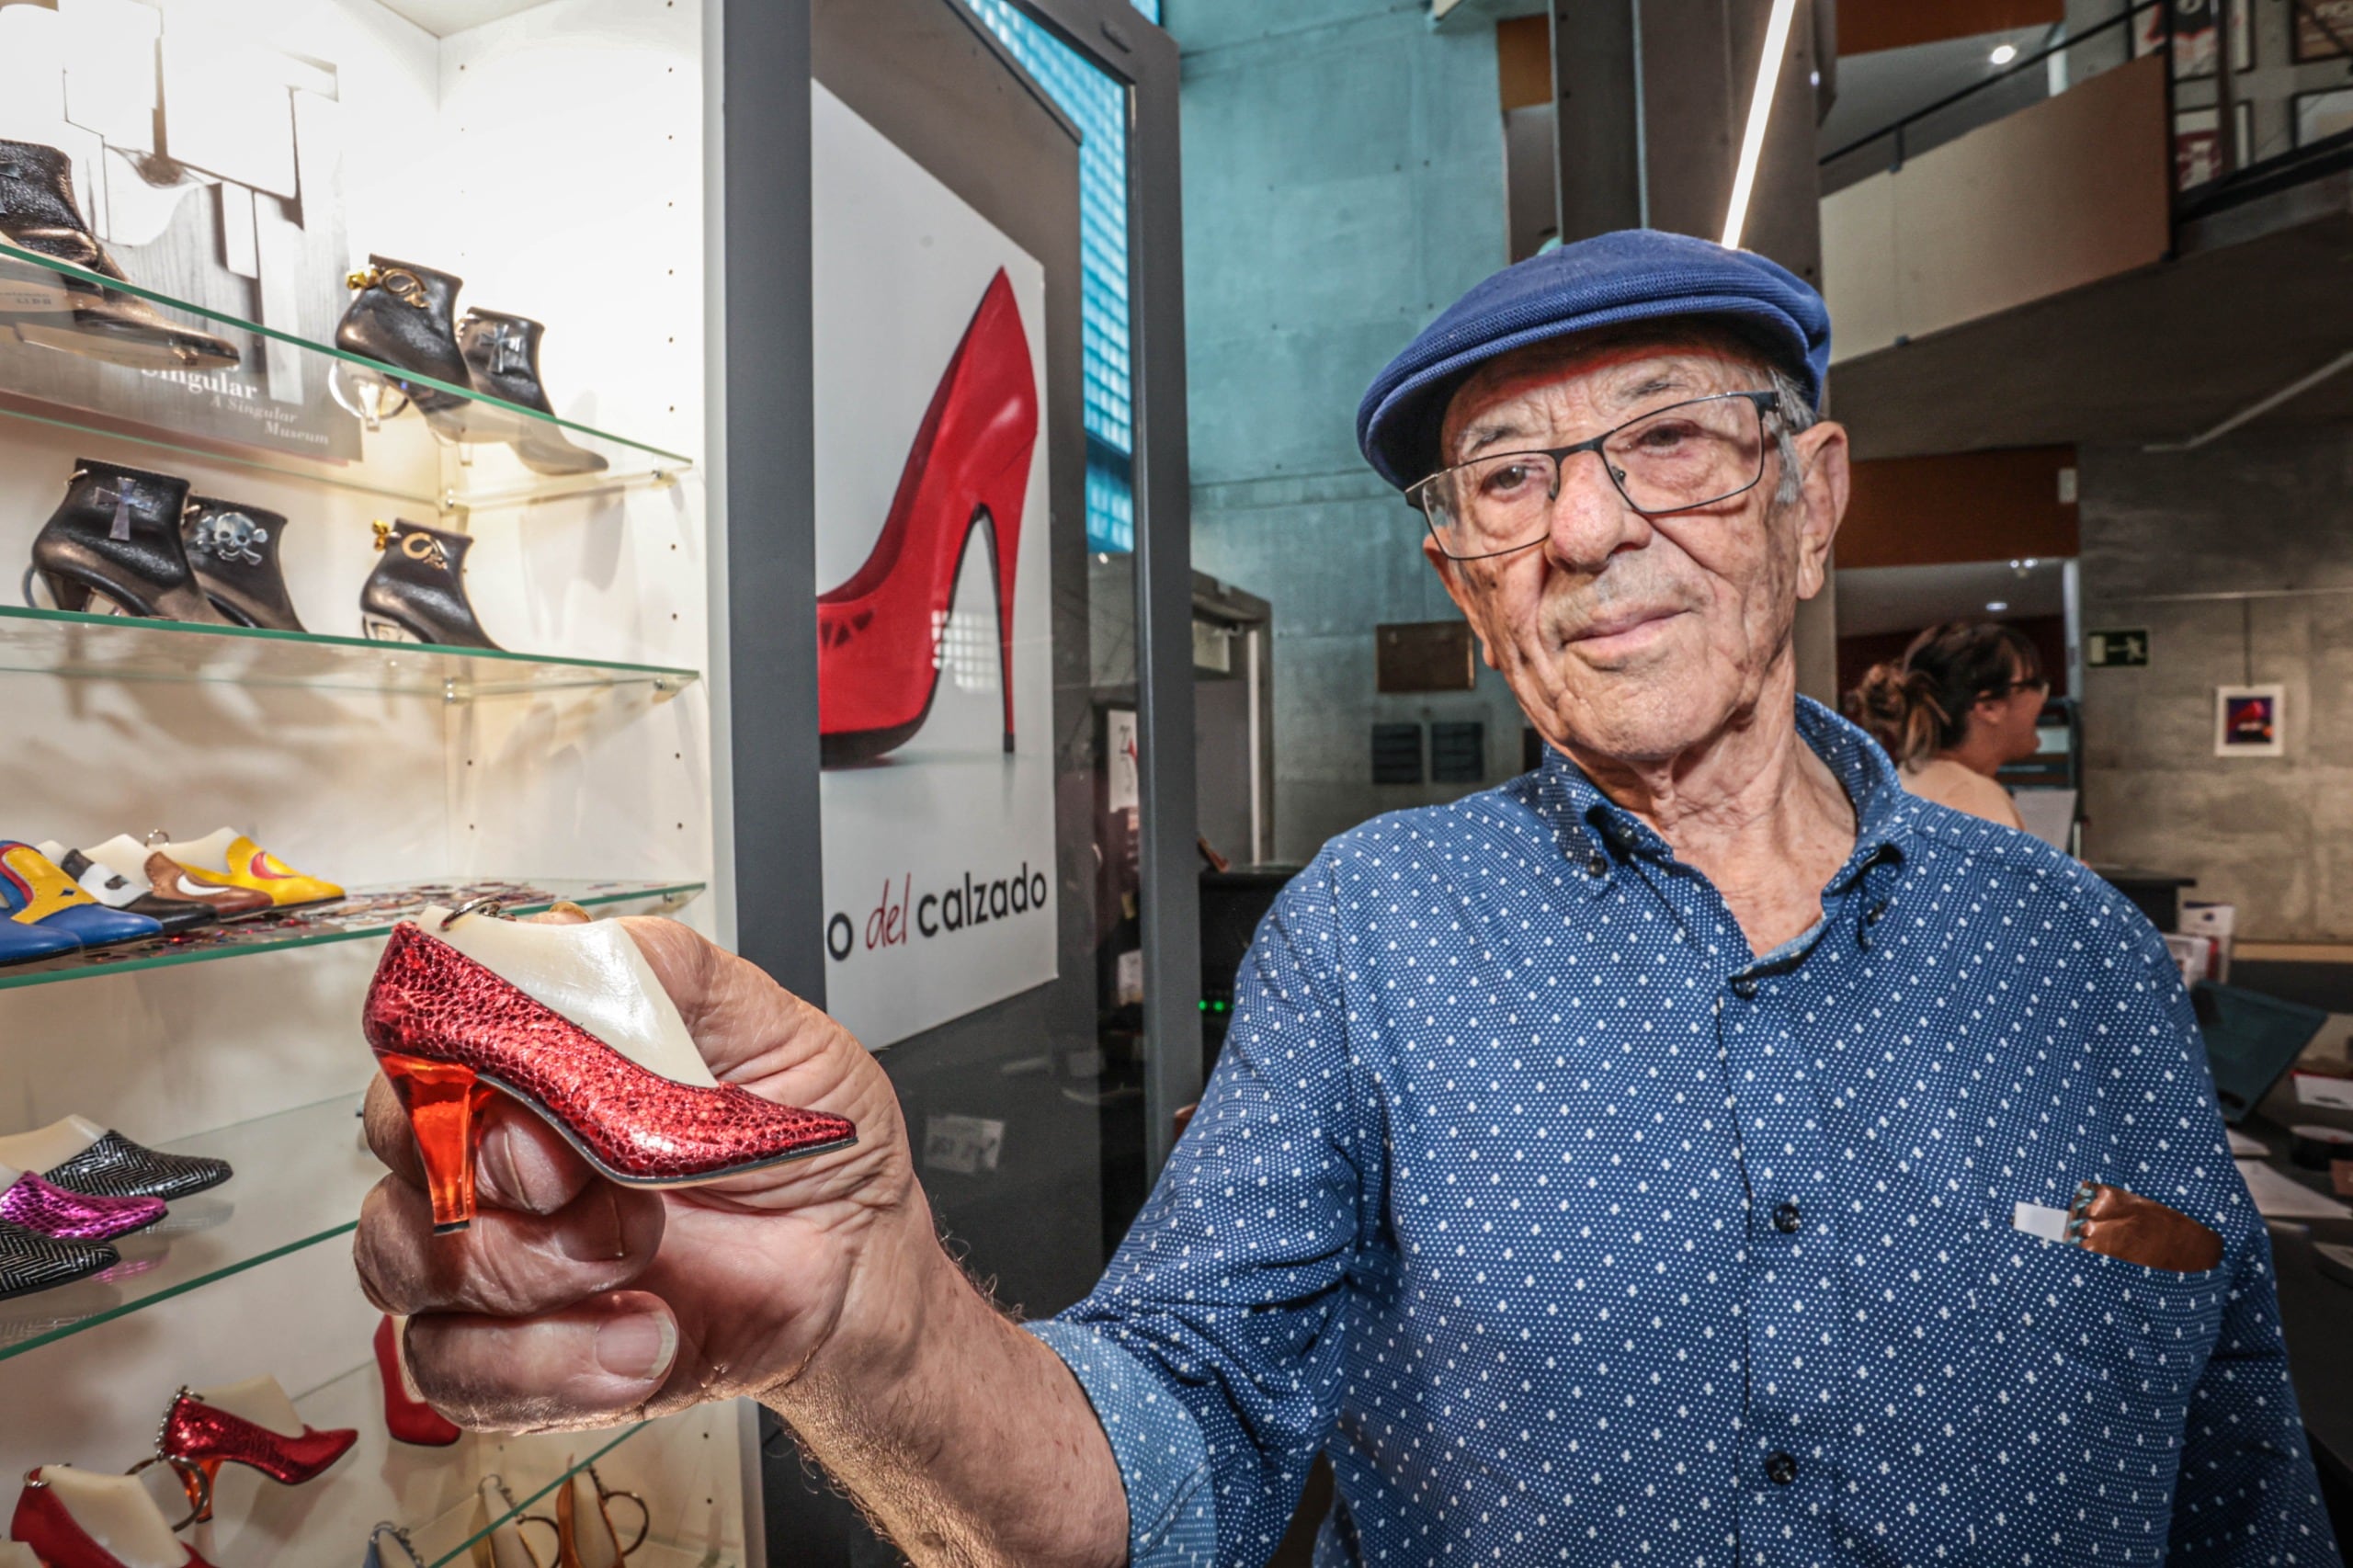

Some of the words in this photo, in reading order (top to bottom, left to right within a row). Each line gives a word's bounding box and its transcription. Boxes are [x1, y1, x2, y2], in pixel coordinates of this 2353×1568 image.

[210, 395, 222, 409] A
[227, 397, 298, 425] Singular
[264, 420, 329, 445] Museum
[865, 871, 911, 950] del
[916, 861, 1047, 938] calzado
